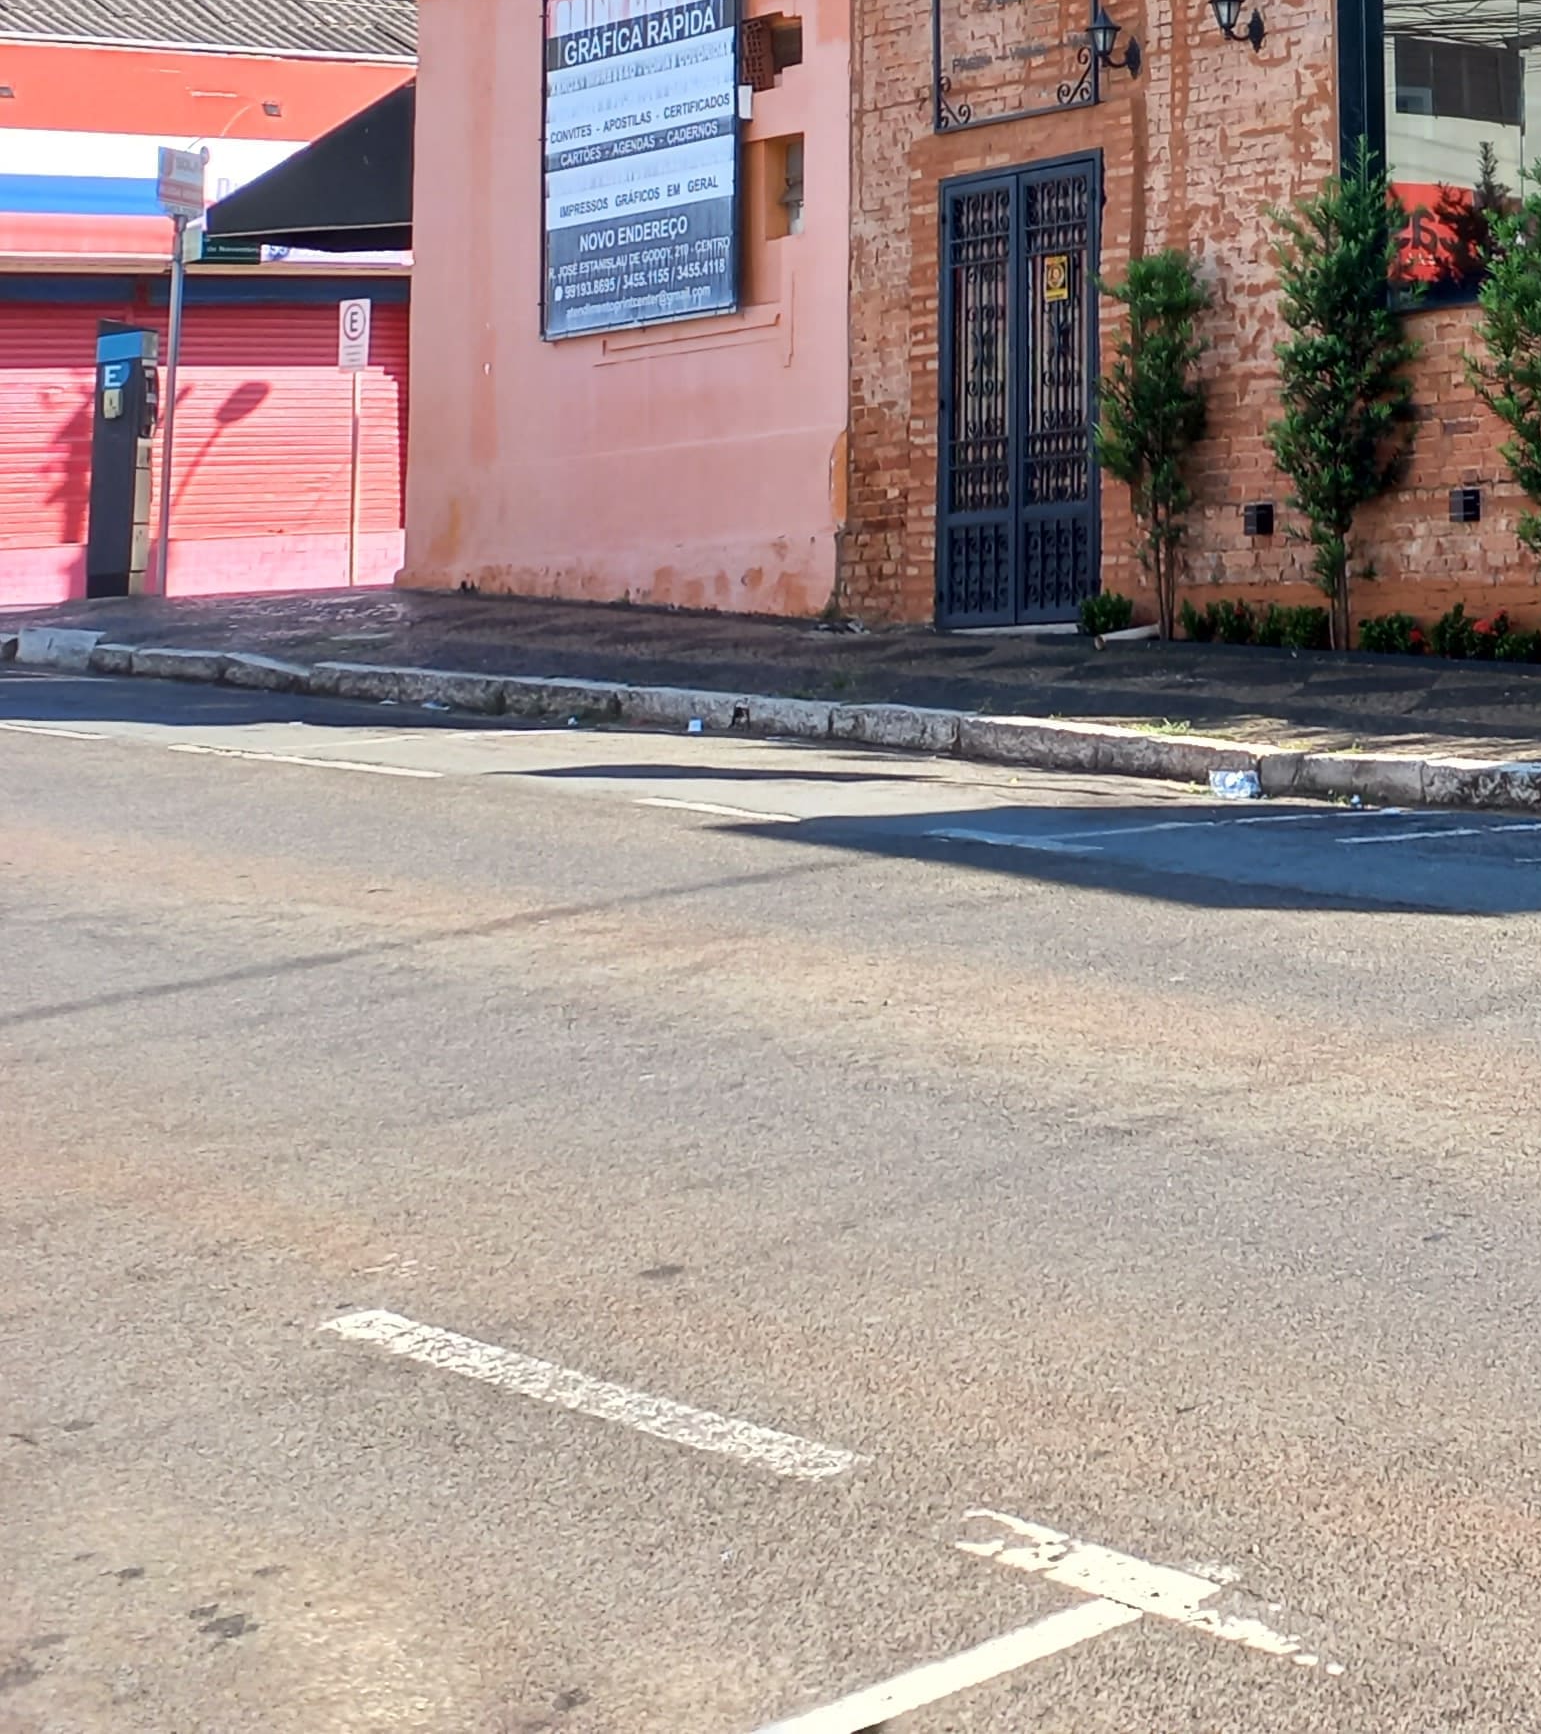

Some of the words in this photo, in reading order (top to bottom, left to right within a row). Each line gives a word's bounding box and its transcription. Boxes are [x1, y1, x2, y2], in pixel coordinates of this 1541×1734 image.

[564, 24, 643, 66] GRÁFICA
[647, 4, 717, 48] RÁPIDA
[550, 123, 593, 144] CONVITES
[603, 110, 653, 134] APOSTILAS
[664, 92, 731, 120] CERTIFICADOS
[560, 144, 602, 167] CARTÕES
[612, 134, 656, 157] AGENDAS
[666, 120, 719, 146] CADERNOS
[559, 196, 609, 218] IMPRESSOS
[615, 186, 661, 208] GRÁFICOS
[667, 182, 681, 198] EM
[687, 175, 719, 193] GERAL
[579, 229, 615, 253] NOVO
[617, 215, 688, 246] ENDEREÇO
[694, 236, 731, 254] CENTRO
[350, 311, 359, 333] E
[104, 364, 122, 387] E
